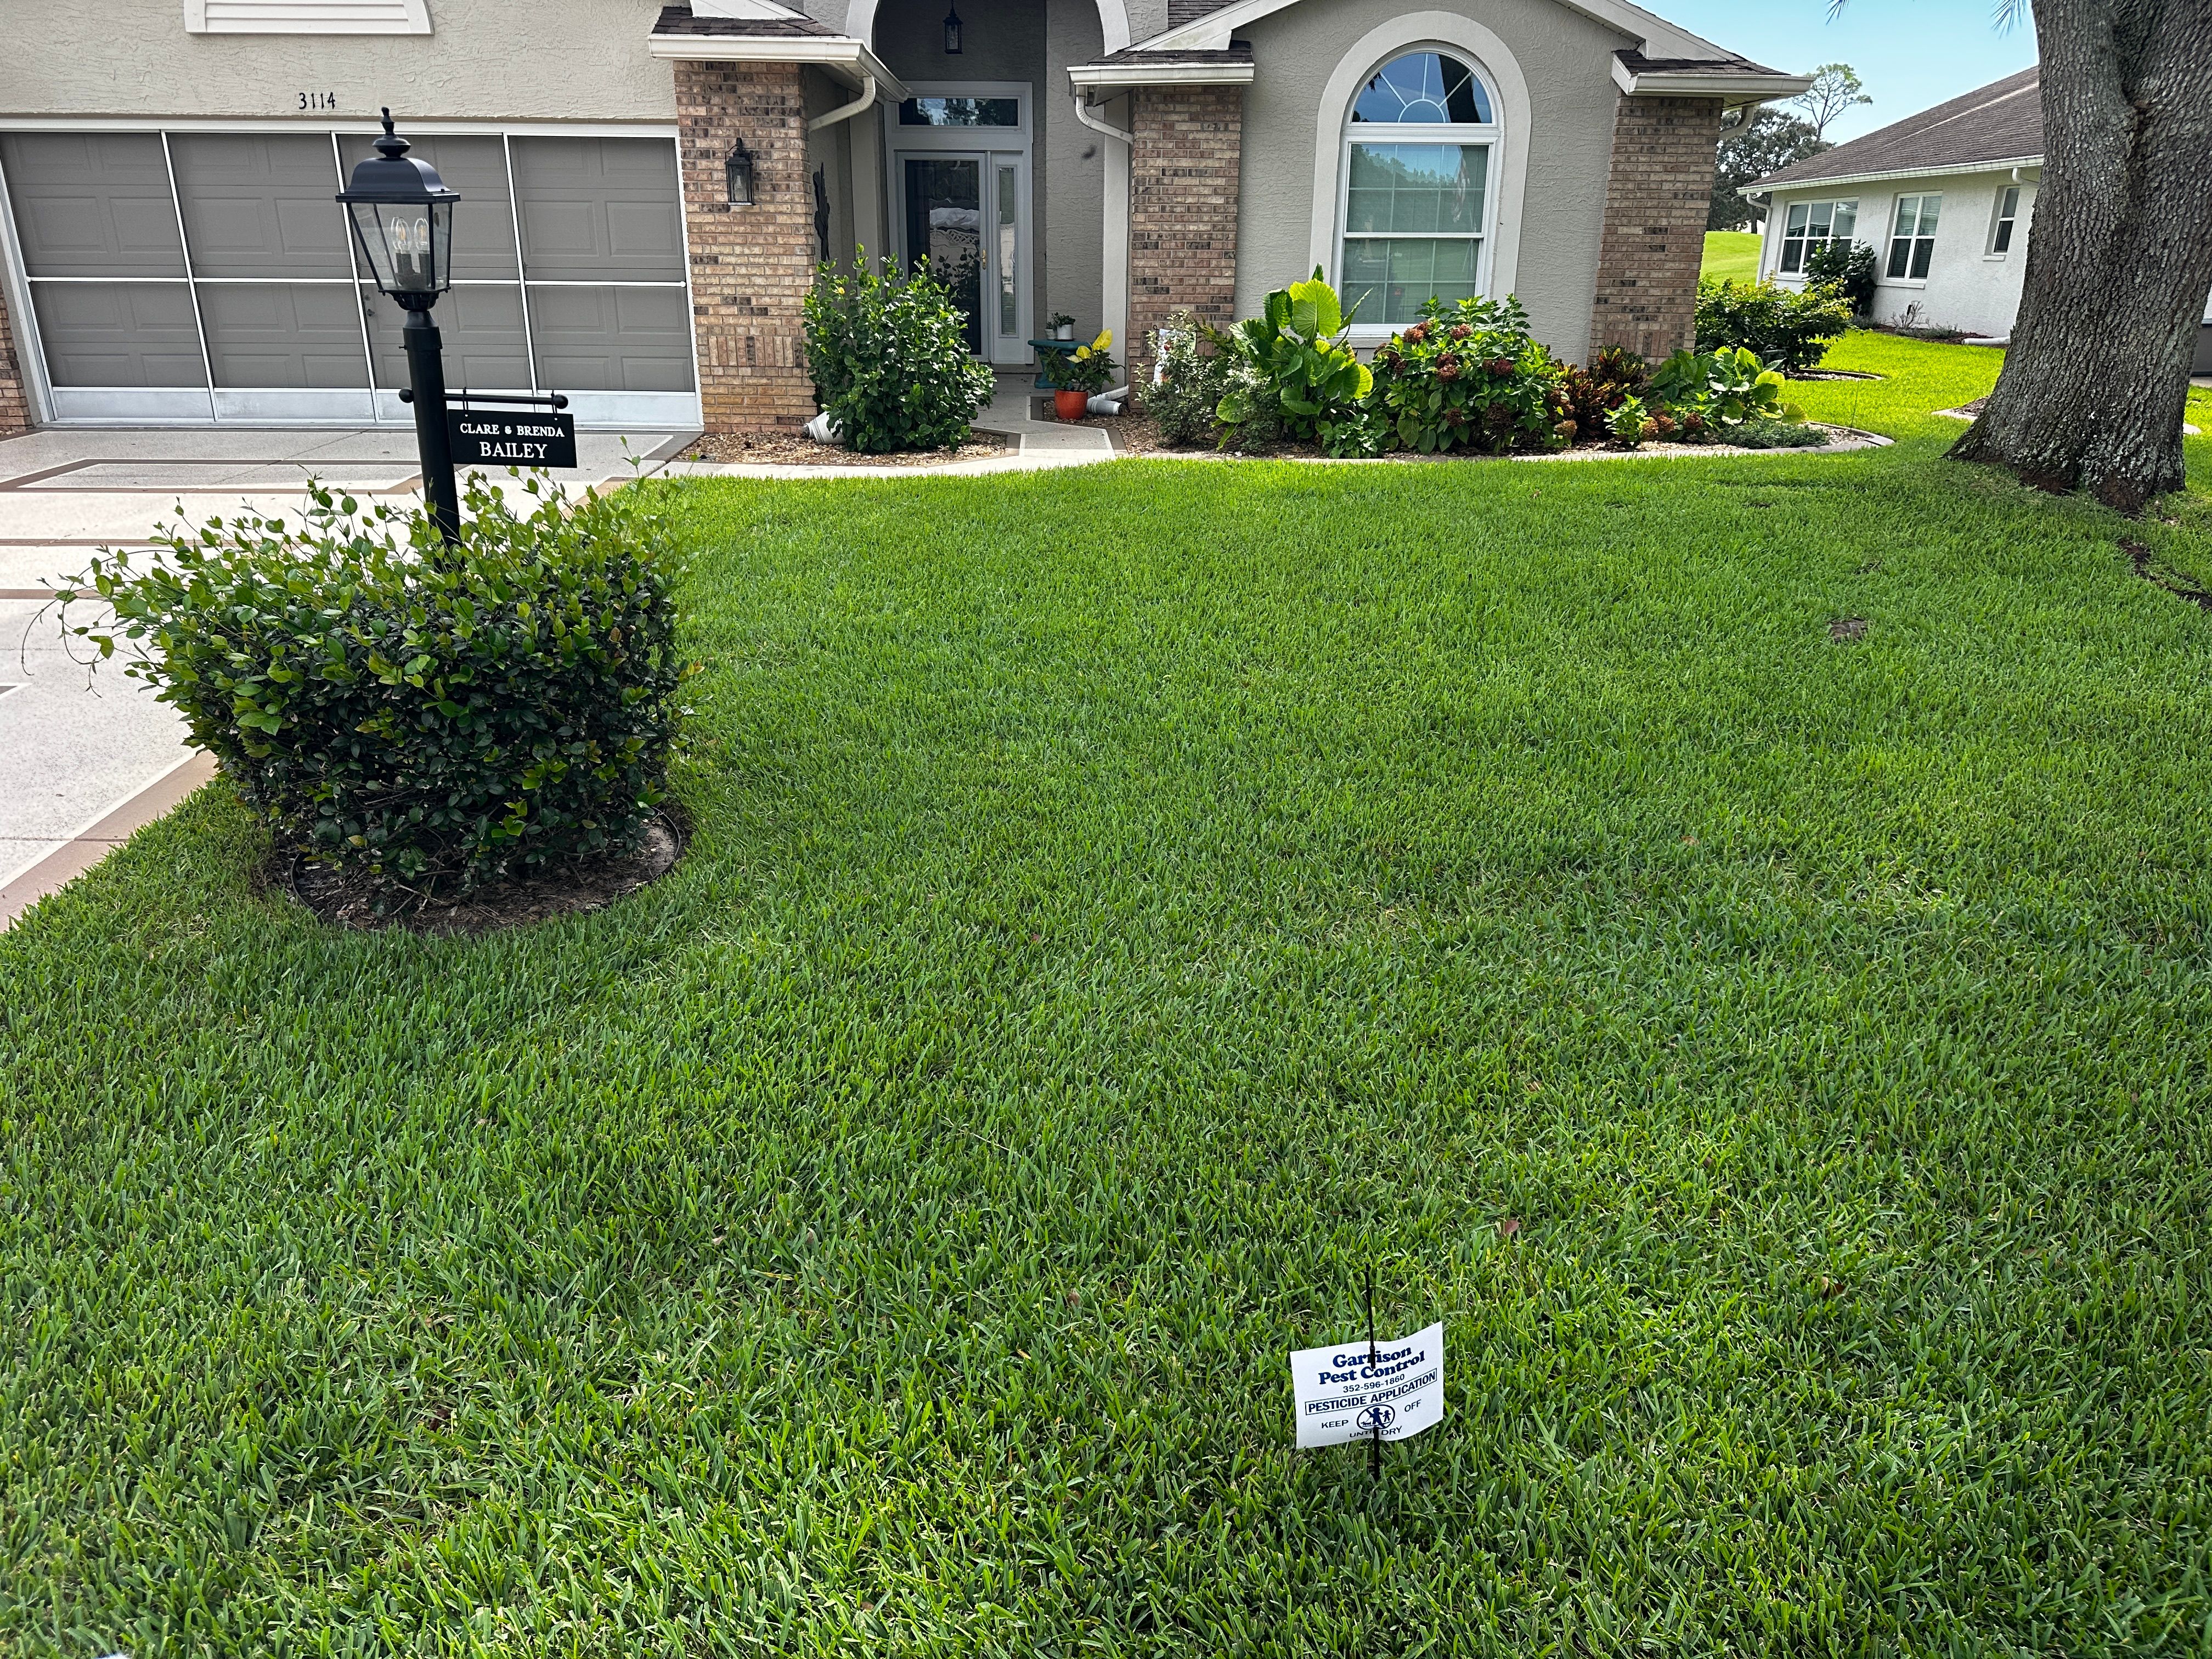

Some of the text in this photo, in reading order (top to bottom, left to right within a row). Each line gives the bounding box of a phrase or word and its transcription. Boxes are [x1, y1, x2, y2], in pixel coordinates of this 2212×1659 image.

[298, 92, 336, 109] 3114
[460, 423, 565, 437] CLARE & BRENDA
[479, 441, 548, 459] BAILEY
[1318, 1350, 1425, 1384] Pest Control
[1308, 1370, 1435, 1413] PESTICIDE APPLICATION
[1343, 1374, 1405, 1393] 352-596-1860
[1321, 1399, 1422, 1429] KEEP OFF
[1381, 1425, 1402, 1435] DRY
